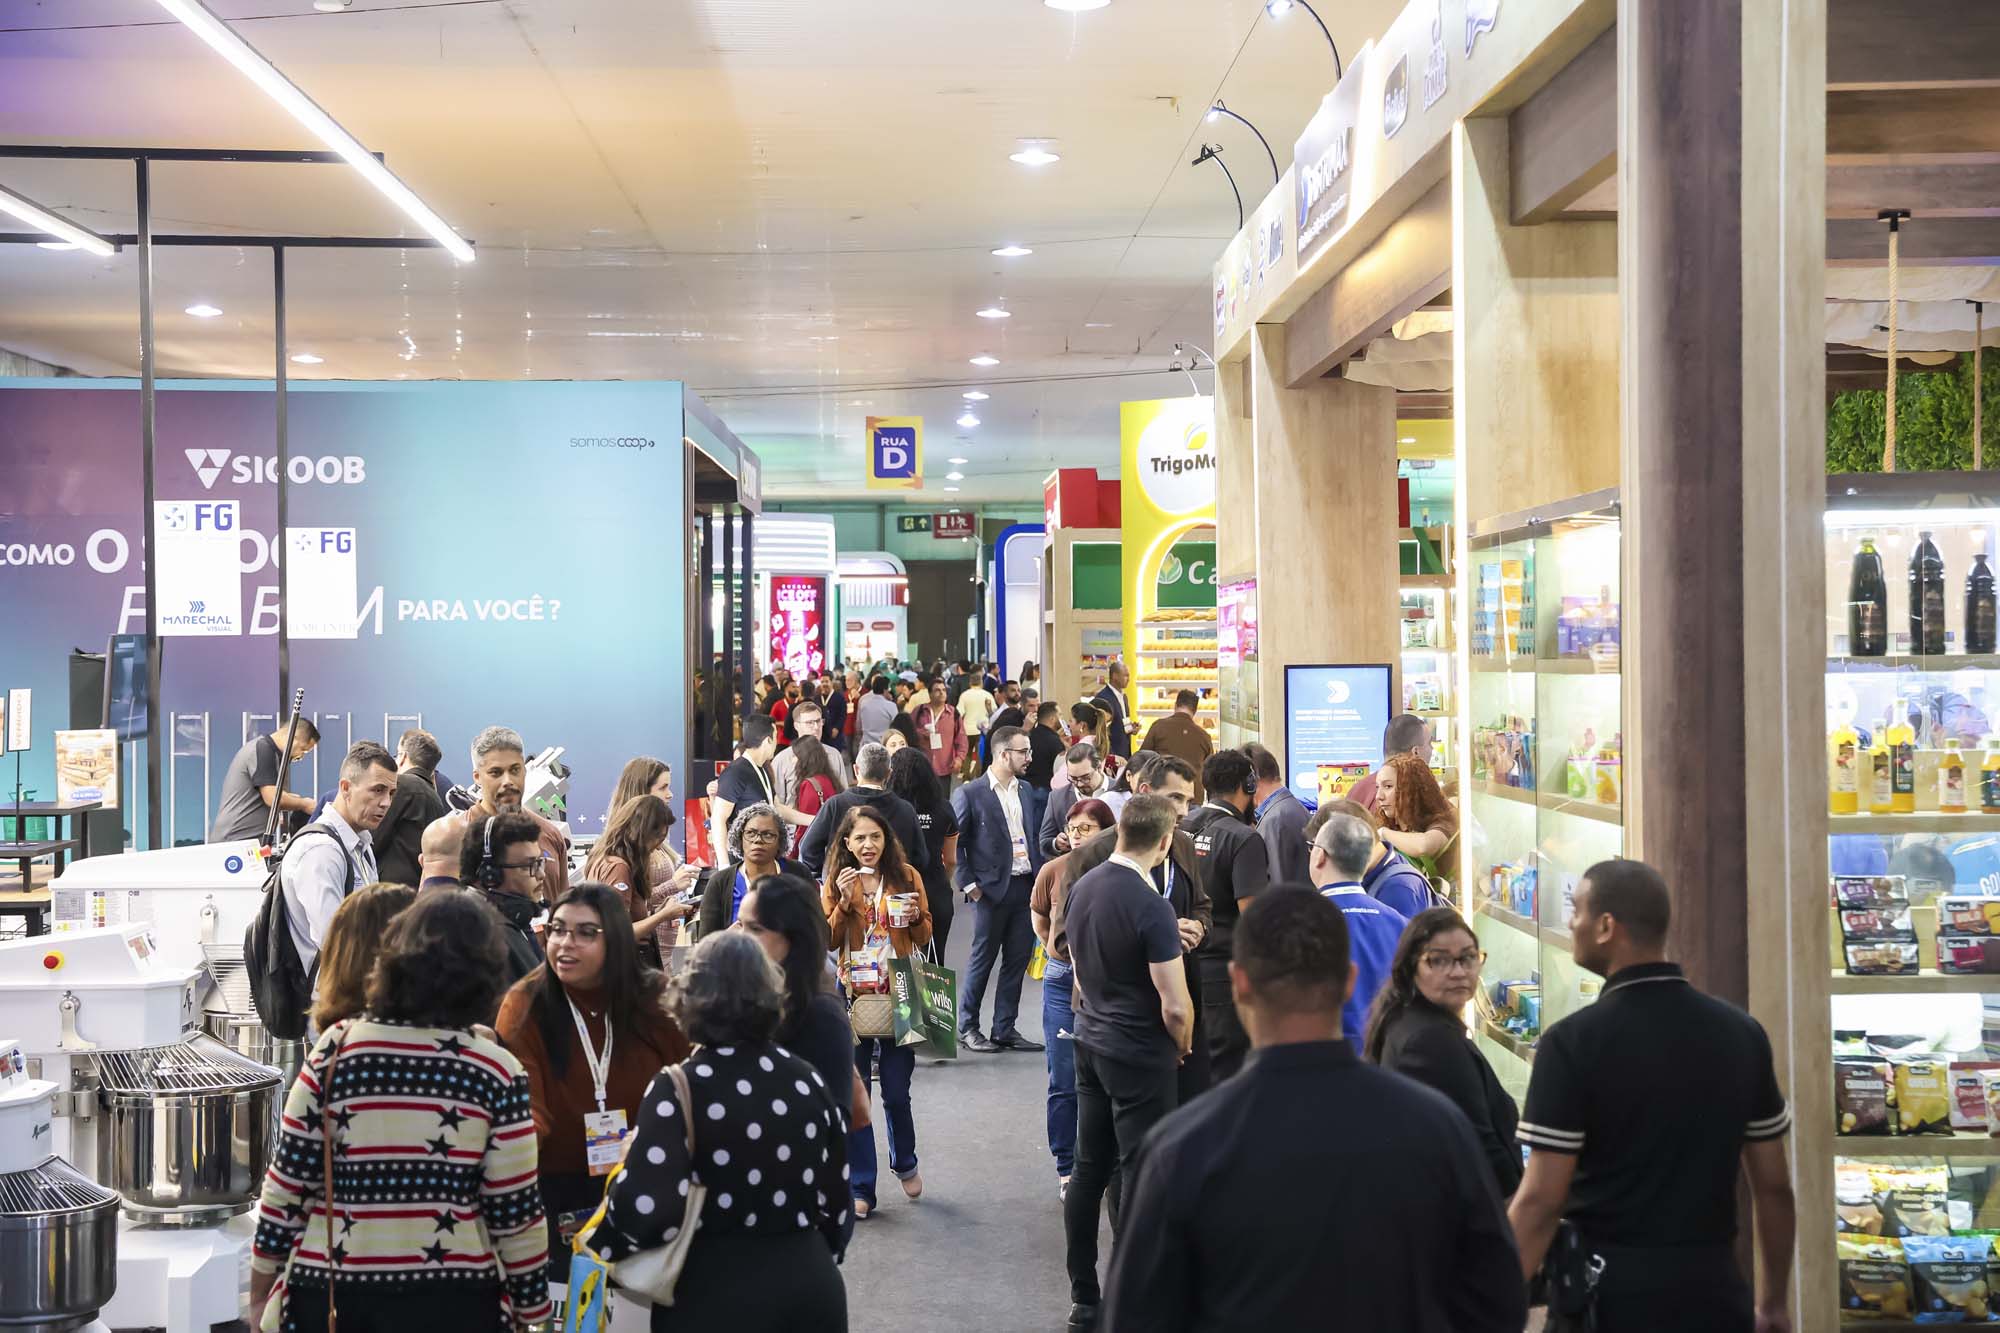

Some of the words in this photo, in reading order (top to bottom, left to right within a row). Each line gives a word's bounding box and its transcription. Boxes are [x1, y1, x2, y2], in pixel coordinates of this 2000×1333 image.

[881, 437, 909, 447] RUA
[883, 447, 908, 470] D
[195, 503, 233, 531] FG
[320, 531, 352, 553] FG
[163, 615, 232, 625] MARECHAL
[398, 599, 469, 621] PARA
[896, 971, 906, 1002] wilso
[931, 988, 953, 1013] wilso
